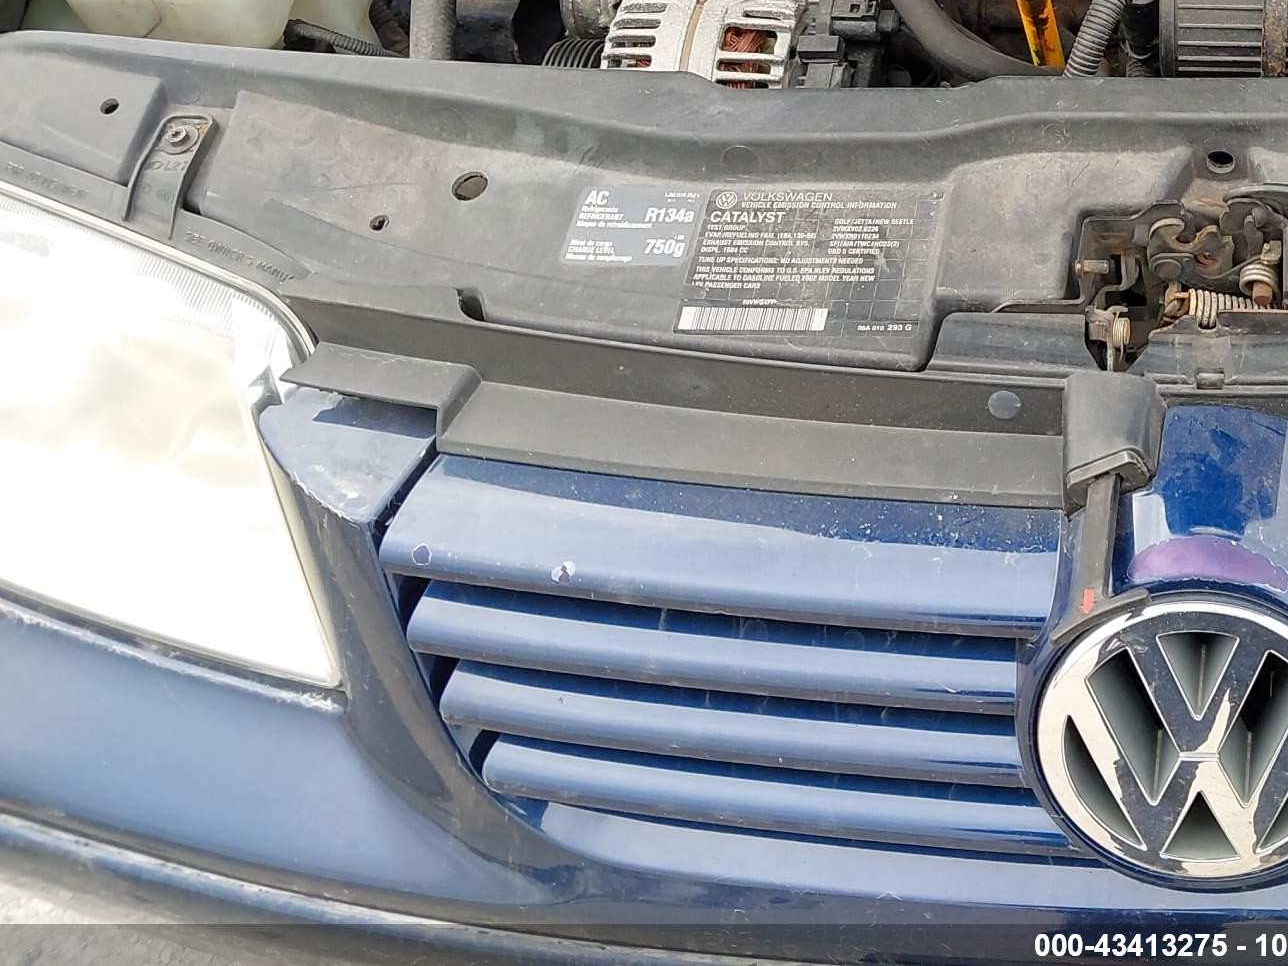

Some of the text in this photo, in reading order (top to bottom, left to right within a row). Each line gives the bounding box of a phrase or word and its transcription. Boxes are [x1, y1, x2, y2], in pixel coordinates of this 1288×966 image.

[585, 190, 610, 205] AC
[743, 192, 833, 202] VOLKSWAGEN
[645, 207, 695, 223] R134a
[710, 211, 786, 223] CATALYST
[643, 238, 686, 258] 750g
[791, 257, 838, 265] ADJUSTMENTS
[739, 266, 774, 274] CONFORMS
[743, 274, 774, 282] GASOLINE
